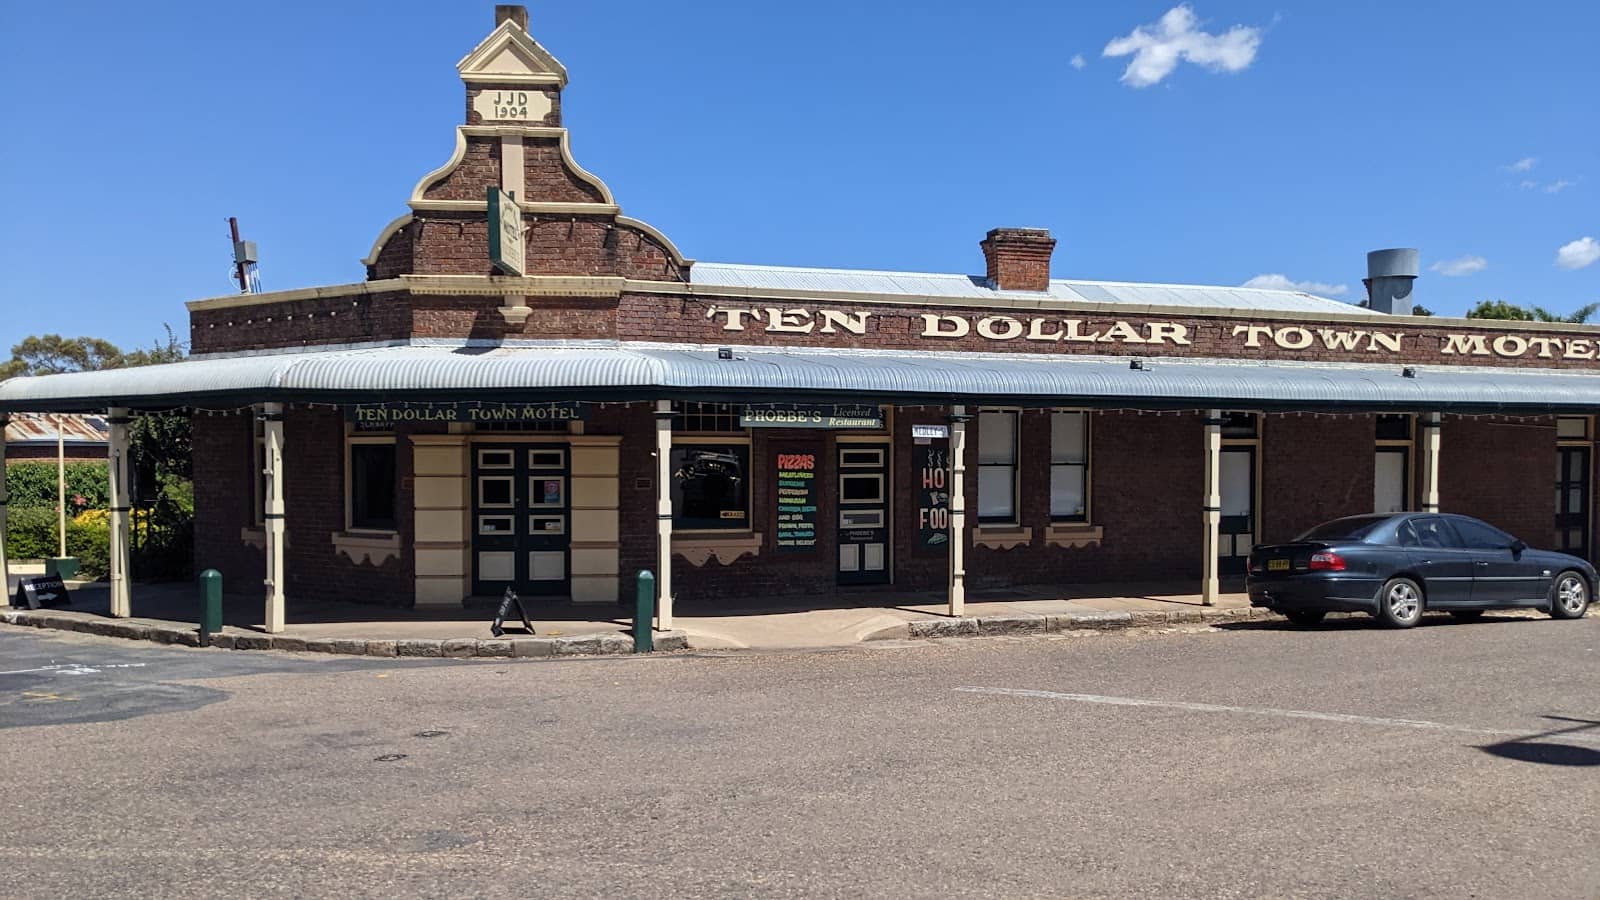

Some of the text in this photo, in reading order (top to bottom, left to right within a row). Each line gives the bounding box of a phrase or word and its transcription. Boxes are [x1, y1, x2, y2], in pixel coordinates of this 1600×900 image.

[495, 106, 528, 119] 1904
[706, 304, 1600, 360] TEN DOLLAR TOWN MOTE
[355, 407, 580, 421] TEN DOLLAR TOWN MOTEL
[744, 409, 822, 423] PHOEBE'S
[833, 407, 872, 417] Licensed
[828, 417, 876, 426] Restaurant
[777, 454, 815, 470] PIZZAS
[923, 467, 950, 489] HO
[919, 507, 948, 530] FOO
